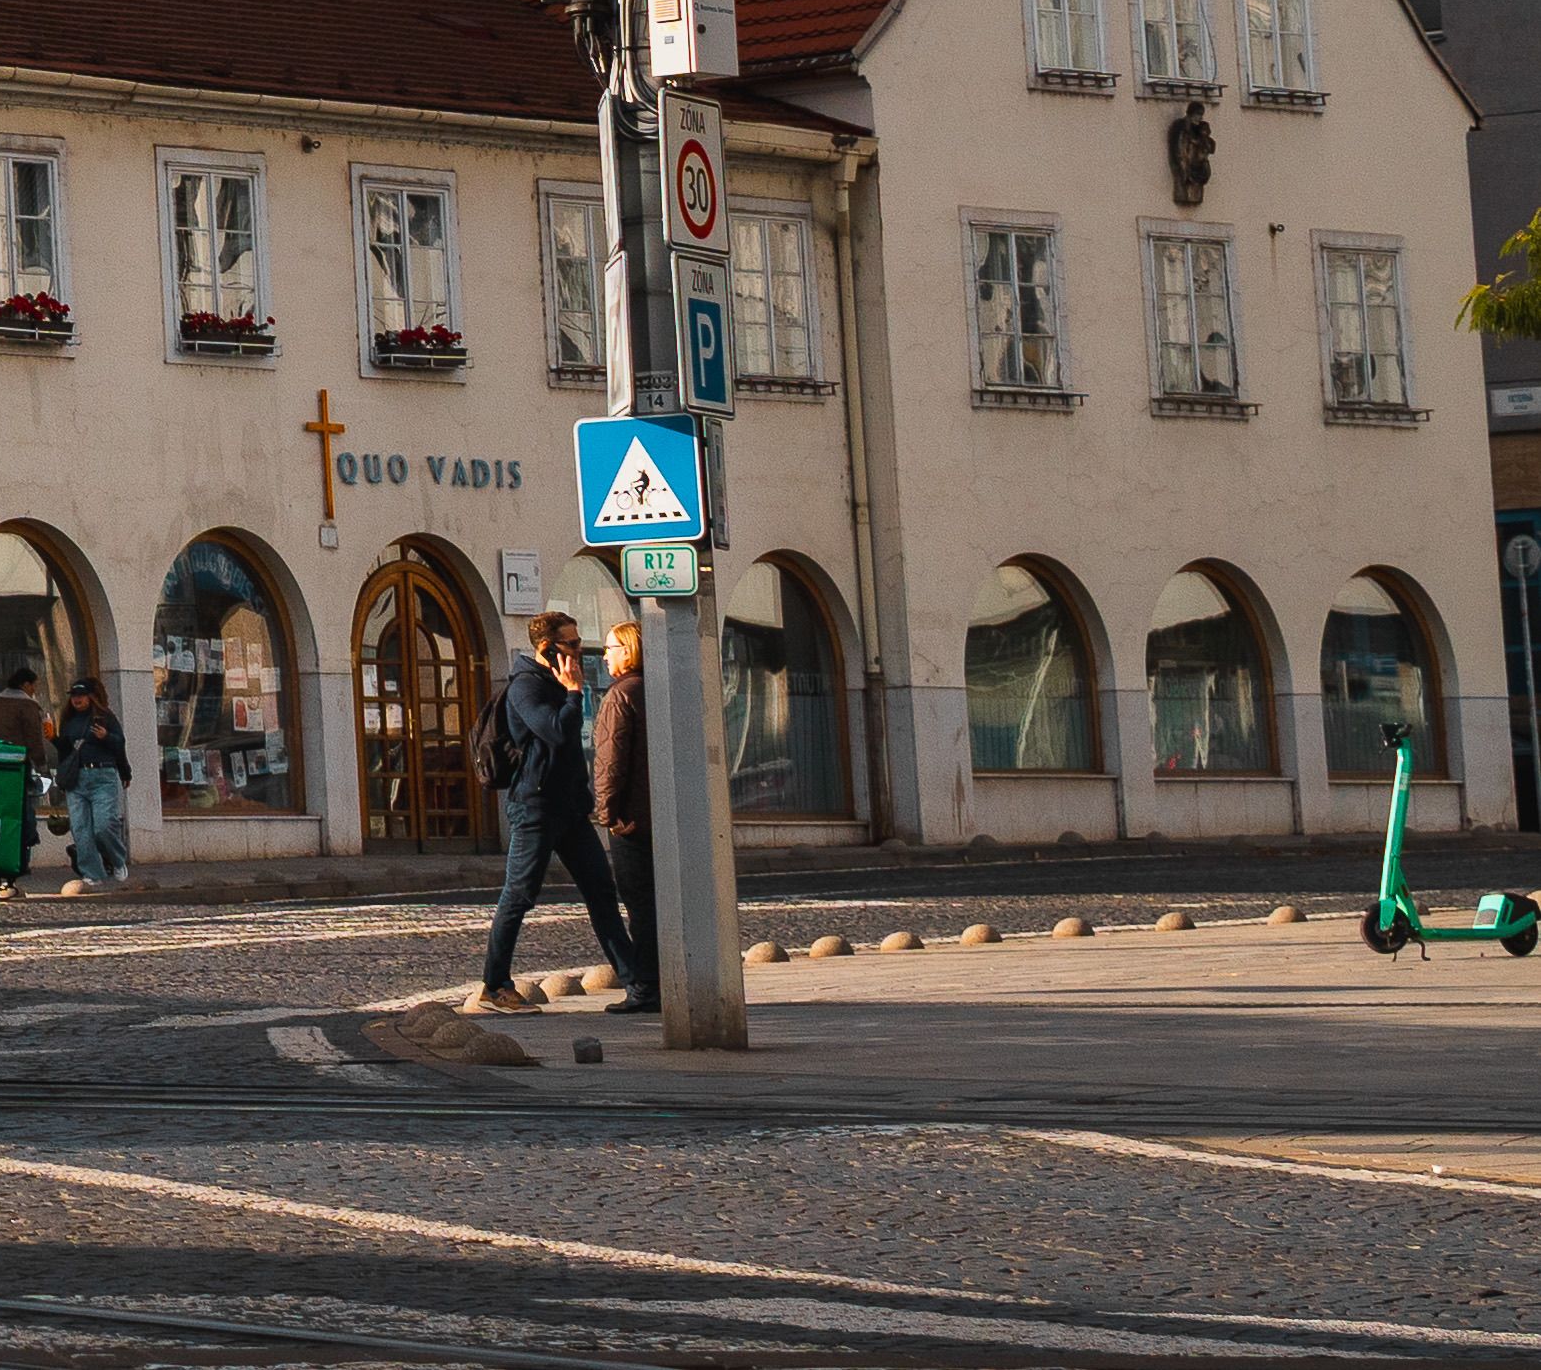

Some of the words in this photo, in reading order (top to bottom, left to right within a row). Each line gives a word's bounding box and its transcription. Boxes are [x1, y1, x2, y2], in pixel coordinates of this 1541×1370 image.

[680, 104, 706, 134] ZÓNA
[684, 165, 709, 212] 30
[691, 265, 715, 295] ZÓNA
[696, 312, 715, 388] P
[646, 393, 665, 409] 14
[336, 451, 409, 486] QUO
[425, 455, 523, 489] VADIS
[644, 553, 675, 570] R12
